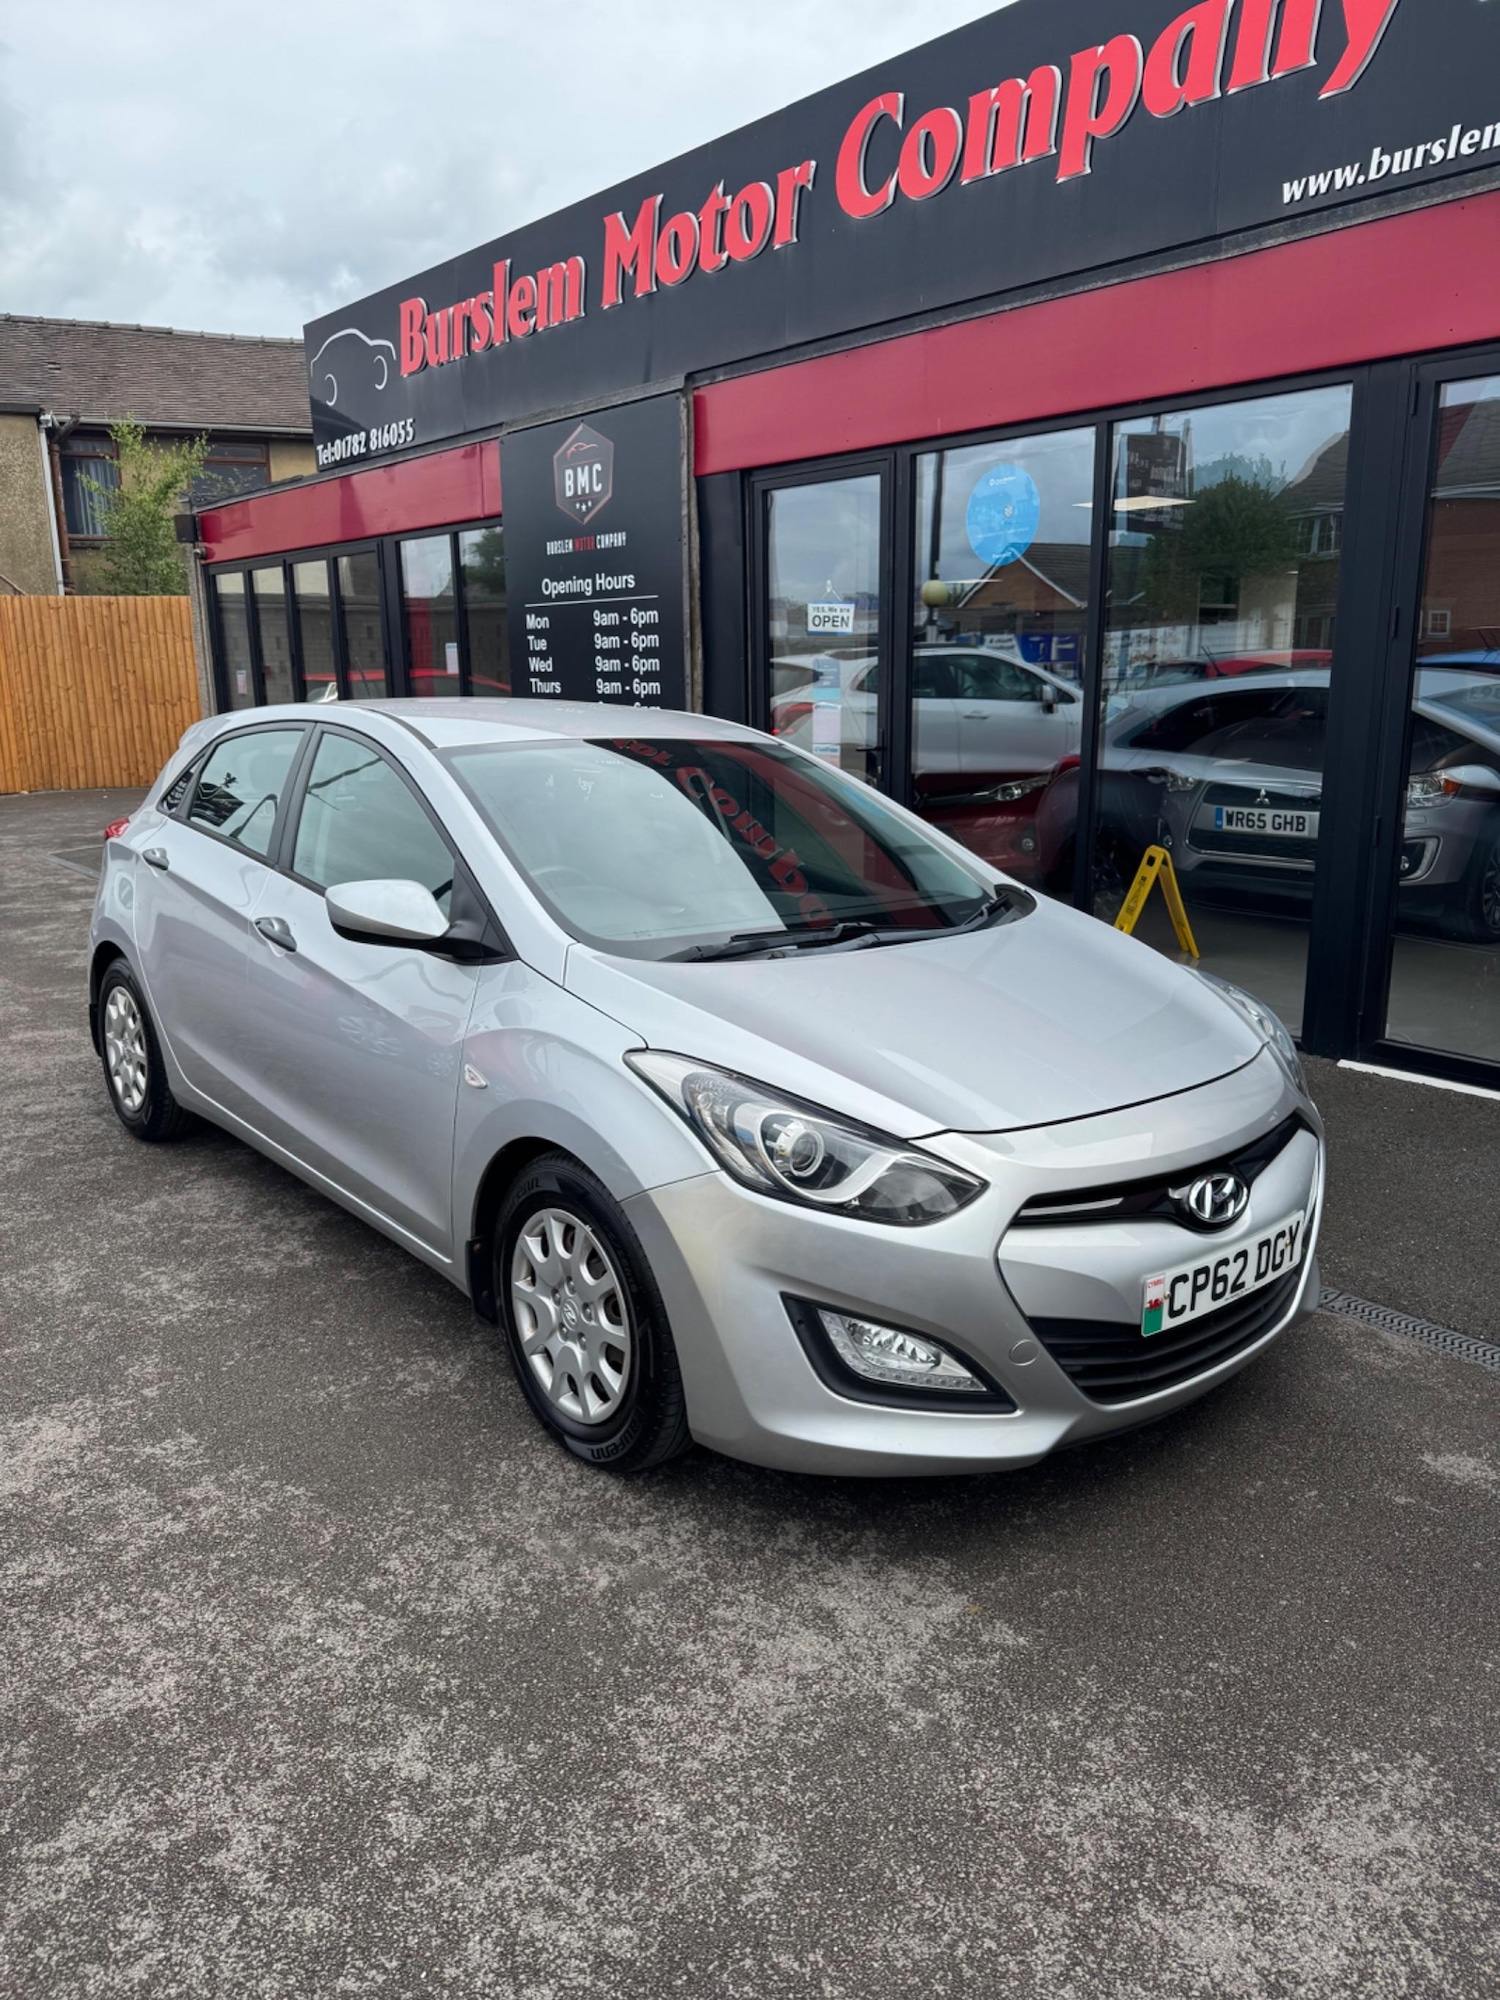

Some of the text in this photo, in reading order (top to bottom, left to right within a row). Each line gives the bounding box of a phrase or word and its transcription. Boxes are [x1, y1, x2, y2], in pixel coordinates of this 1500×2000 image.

[400, 0, 1400, 377] Burslem Motor Company
[316, 418, 416, 466] Tel:01782 816055
[564, 463, 603, 498] BMC
[546, 538, 574, 556] BURSLEM
[596, 531, 627, 549] COMPANY
[541, 573, 636, 599] Opening Hours
[526, 614, 550, 630] Mon
[593, 609, 620, 627] 9am
[630, 607, 659, 628] 6pm
[811, 615, 850, 628] OPEN
[527, 635, 548, 651] Tue
[594, 632, 620, 649] 9am
[631, 631, 660, 652] 6pm
[528, 657, 553, 673] Wed
[595, 655, 622, 672] 9am
[631, 654, 661, 676] 6pm
[529, 678, 562, 694] Thurs
[596, 677, 622, 695] 9am
[632, 677, 661, 699] 6pm
[1225, 809, 1306, 832] WR65 GHB
[1168, 1220, 1300, 1319] CP62 DGY
